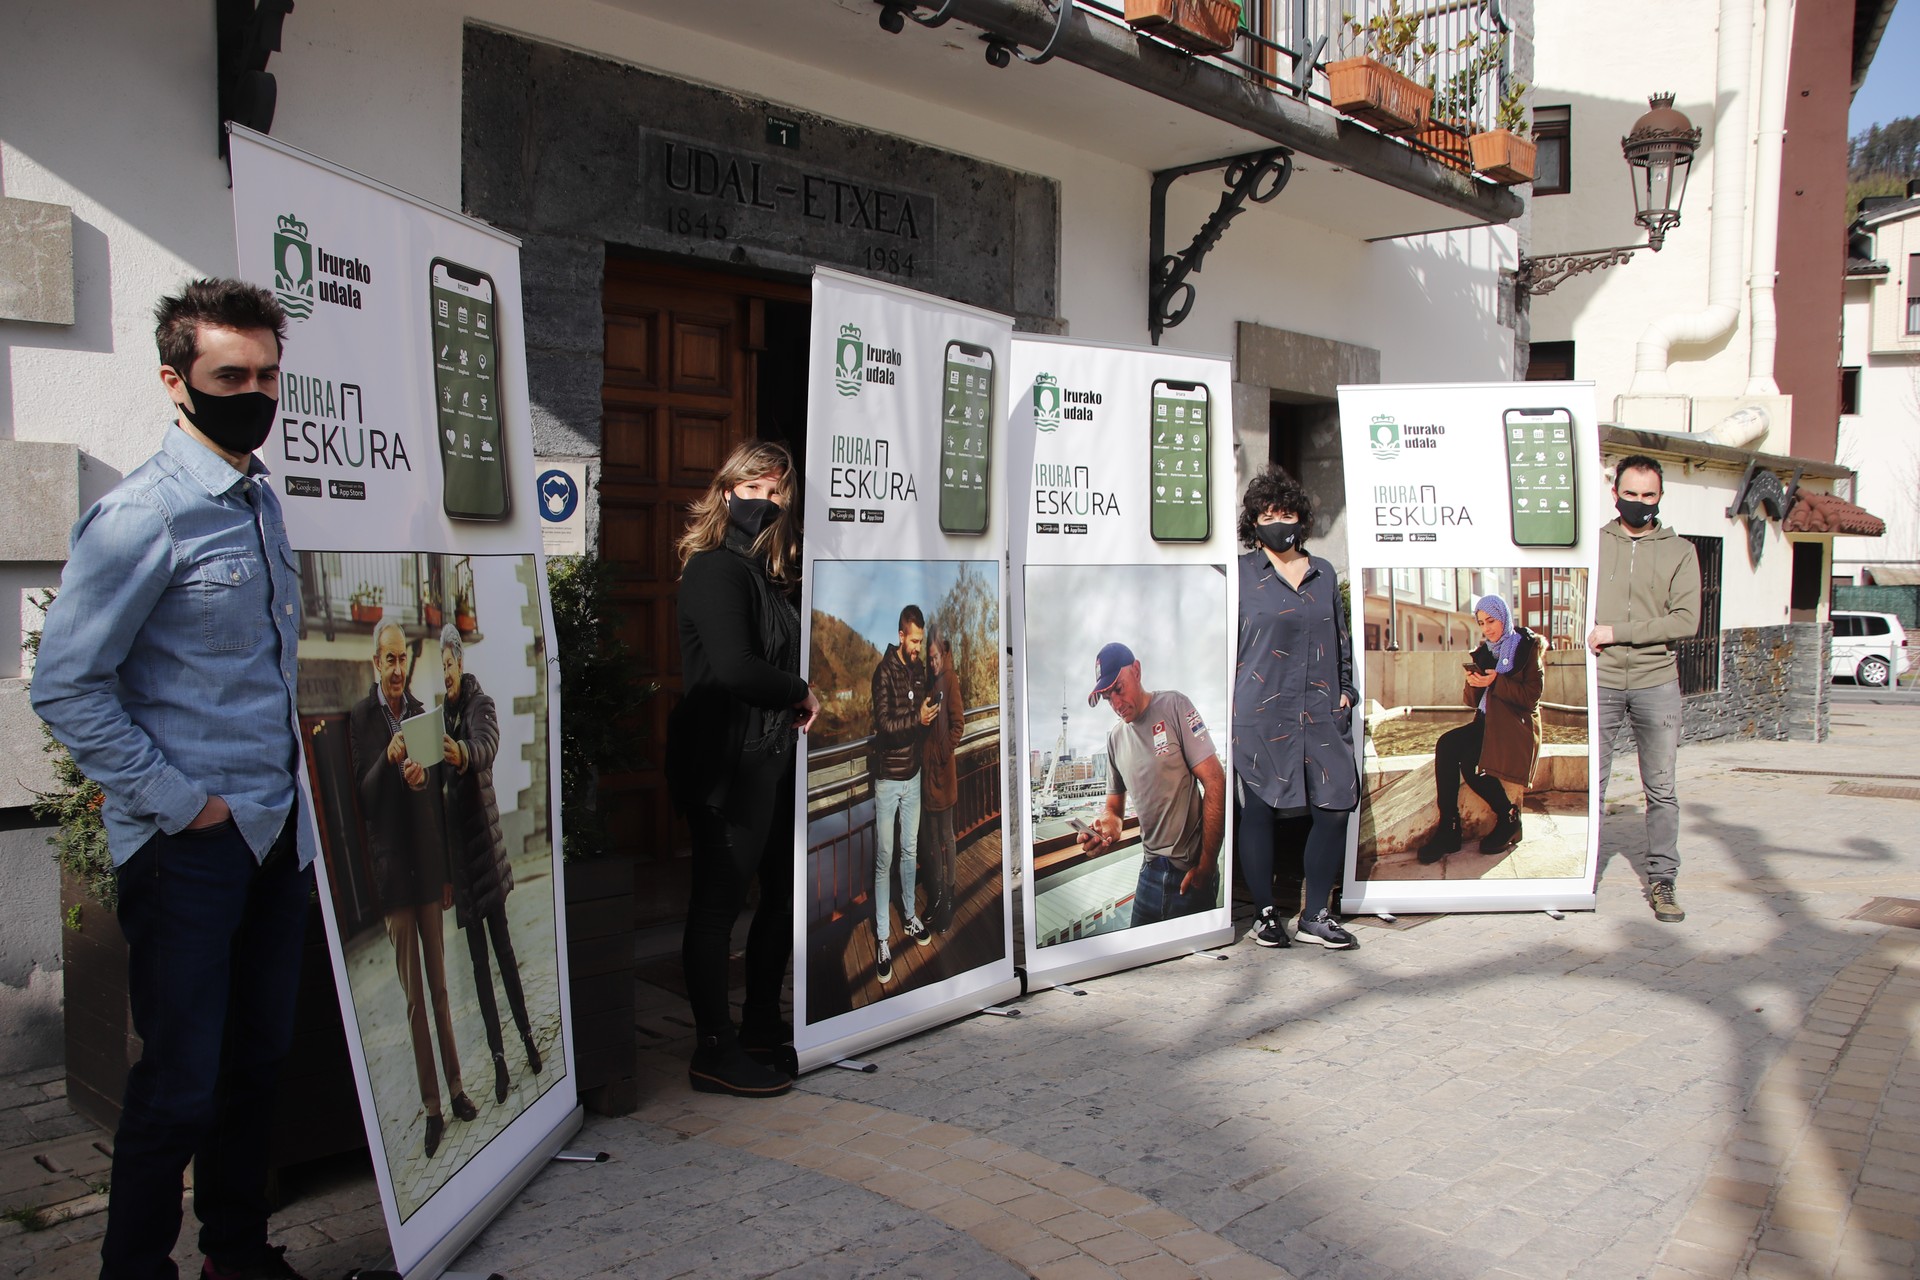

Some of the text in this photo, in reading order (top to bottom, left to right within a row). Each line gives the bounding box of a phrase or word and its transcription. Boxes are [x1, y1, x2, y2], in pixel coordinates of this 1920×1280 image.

[780, 130, 786, 144] 1
[664, 142, 919, 240] UDAL-ETXEA
[318, 247, 371, 285] Irurako
[864, 245, 914, 278] 1984
[318, 280, 362, 310] udala
[866, 344, 902, 366] Irurako
[866, 366, 895, 386] udala
[280, 372, 336, 419] IRURA
[1064, 388, 1102, 405] Irurako
[1064, 406, 1093, 421] udala
[1404, 424, 1446, 436] Irurako
[282, 418, 412, 472] ESKURA
[832, 434, 872, 466] IRURA
[1404, 438, 1437, 449] udala
[830, 467, 918, 502] ESKURA
[1036, 464, 1072, 488] IRURA
[340, 488, 349, 497] App
[1036, 490, 1120, 516] ESKURA
[1374, 486, 1418, 504] IRURA
[1375, 506, 1474, 526] ESKURA
